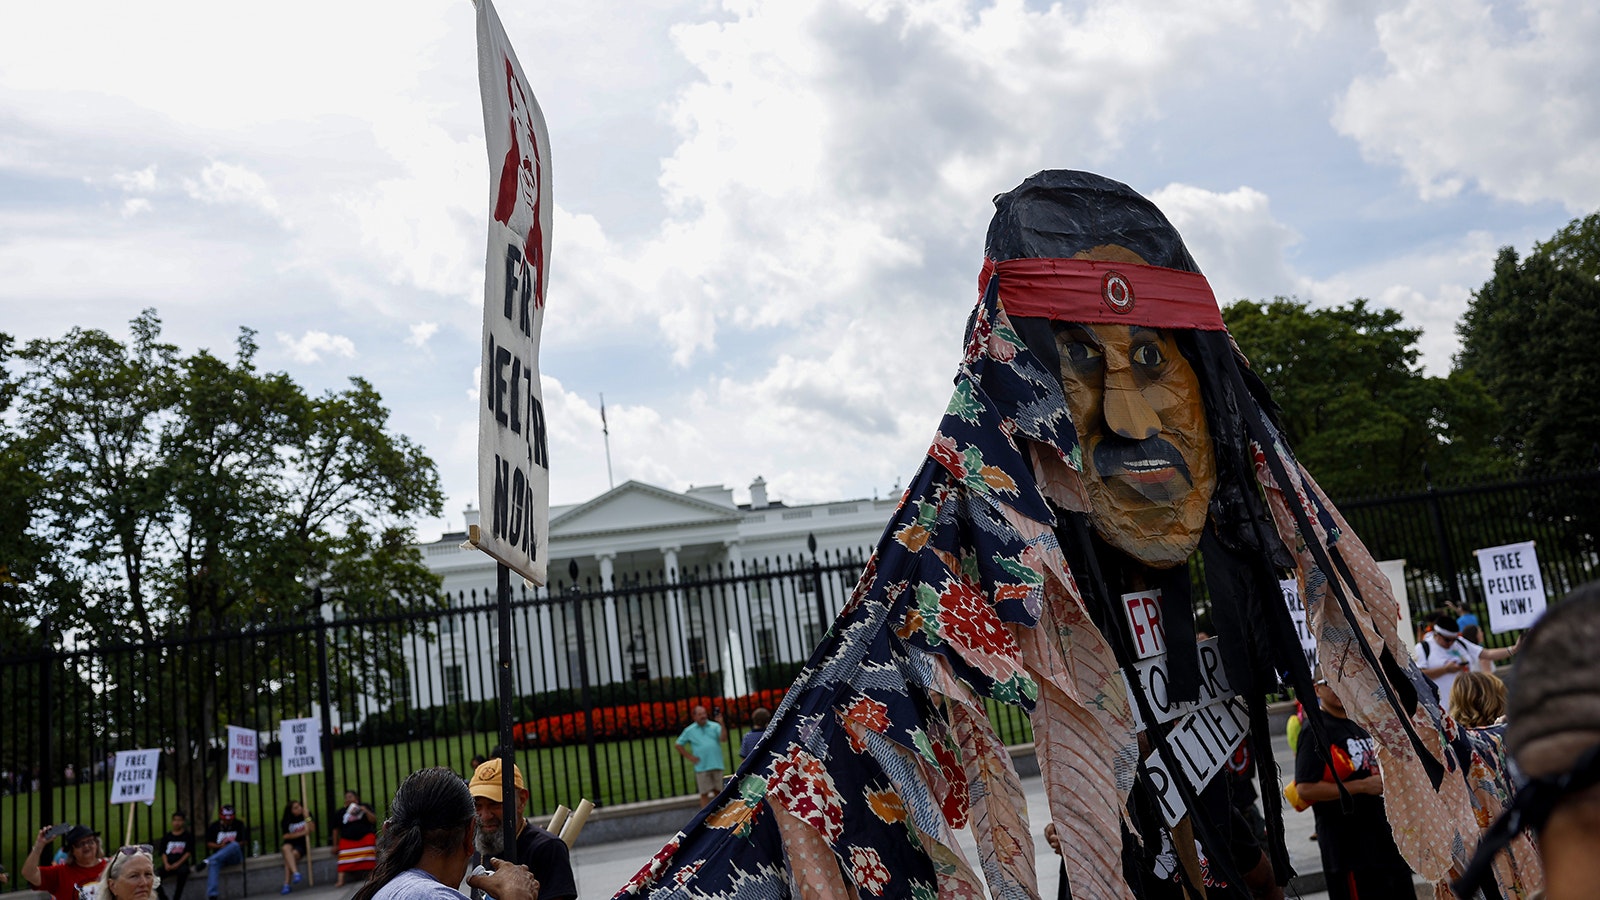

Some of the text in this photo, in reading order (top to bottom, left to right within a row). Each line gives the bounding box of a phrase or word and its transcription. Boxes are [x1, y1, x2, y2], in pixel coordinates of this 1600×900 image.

[1493, 552, 1523, 571] FREE
[1488, 574, 1536, 594] PELTIER
[1501, 597, 1533, 615] NOW!
[292, 723, 306, 734] RISE
[236, 734, 253, 746] FREE
[296, 735, 304, 745] UP
[294, 746, 307, 756] FOR
[125, 754, 147, 767] FREE
[288, 756, 315, 768] PELTIER
[116, 769, 152, 783] PELTIER
[120, 783, 145, 797] NOW!
